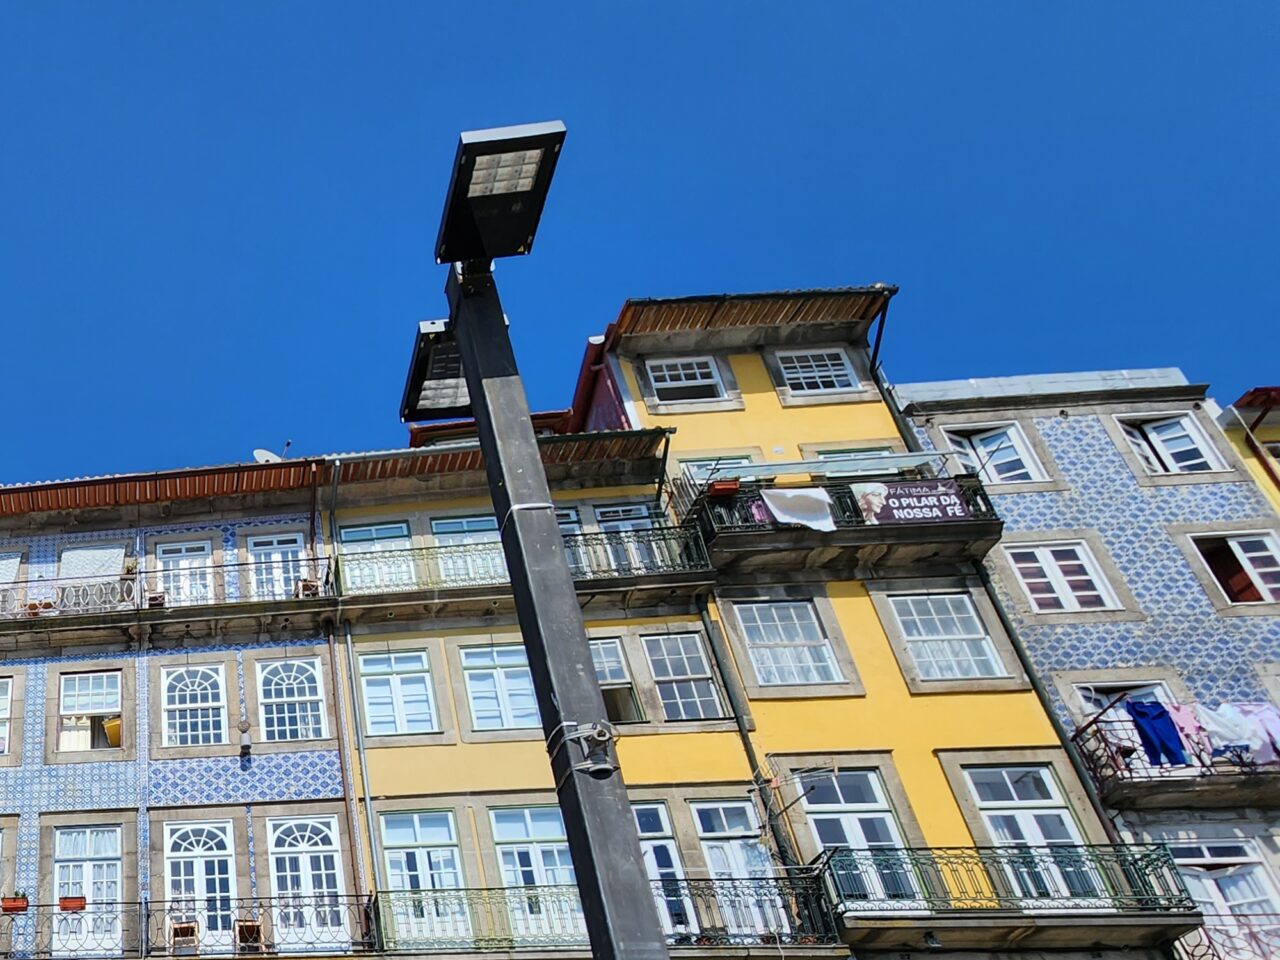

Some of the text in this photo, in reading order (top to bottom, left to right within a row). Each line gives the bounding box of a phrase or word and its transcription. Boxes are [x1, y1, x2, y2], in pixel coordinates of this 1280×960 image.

[888, 494, 960, 508] O PILAR DA
[892, 504, 965, 519] NOSSA FÉ
